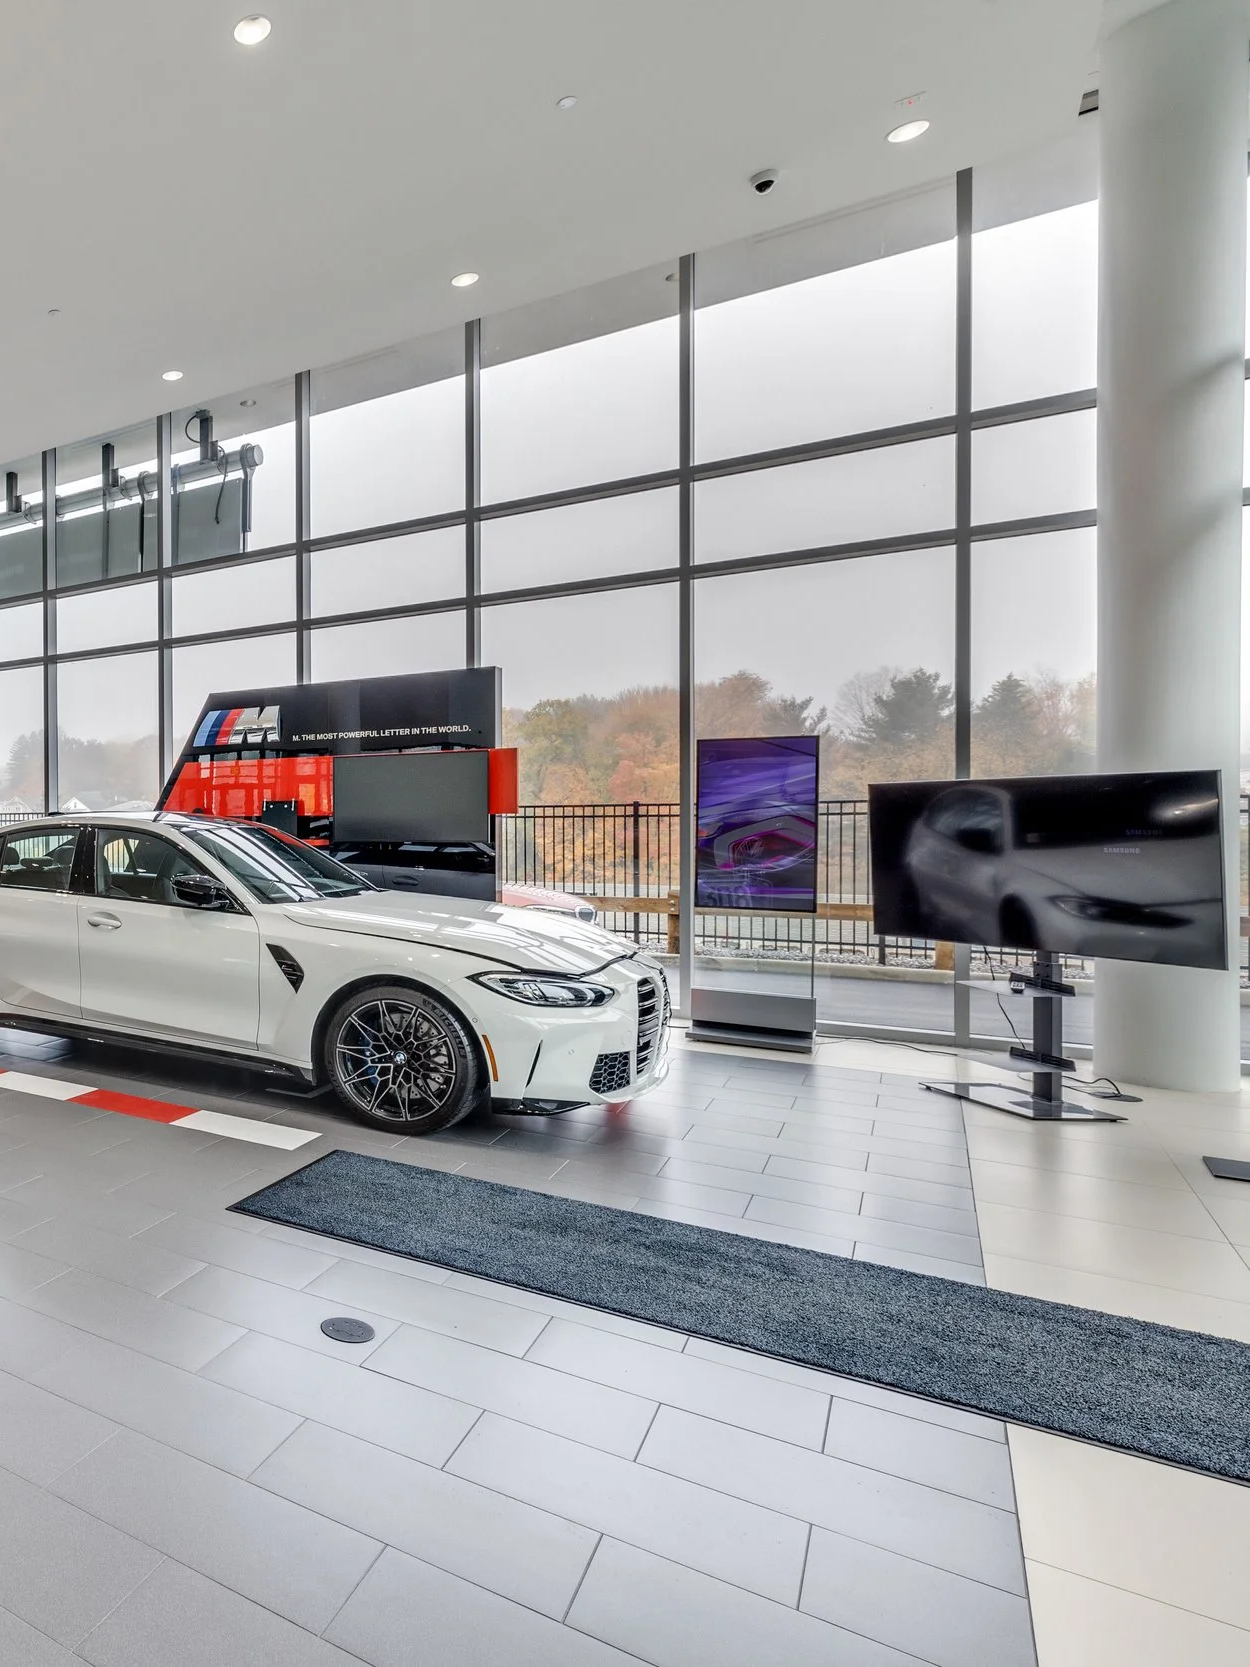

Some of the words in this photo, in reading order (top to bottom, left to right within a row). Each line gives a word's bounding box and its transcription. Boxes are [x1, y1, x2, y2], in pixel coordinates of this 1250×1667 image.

[228, 705, 281, 744] M
[316, 732, 338, 740] MOST
[338, 730, 380, 739] POWERFUL
[380, 728, 410, 737] LETTER
[411, 727, 420, 735] IN
[421, 726, 438, 734] THE
[438, 724, 472, 733] WORLD.
[434, 1008, 467, 1057] MICHELIN
